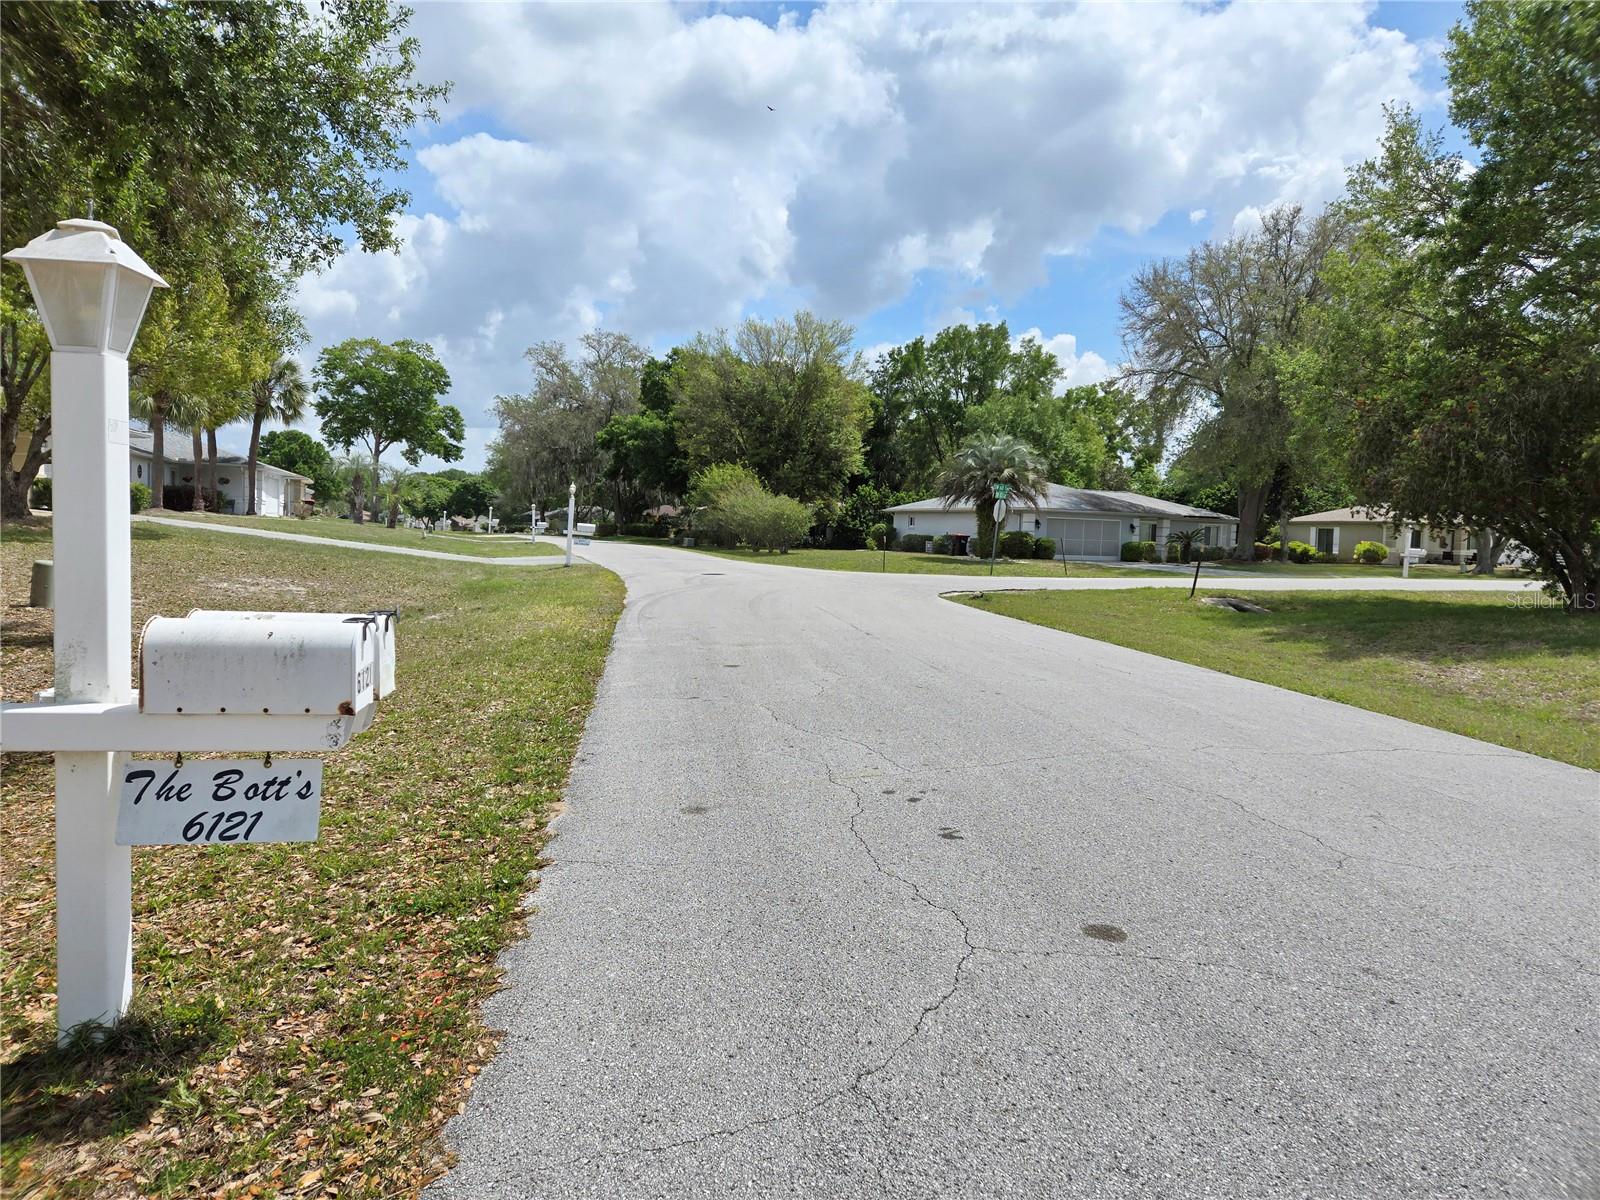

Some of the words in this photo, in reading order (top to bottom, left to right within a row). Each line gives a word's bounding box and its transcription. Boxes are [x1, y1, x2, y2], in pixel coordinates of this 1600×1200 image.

[125, 769, 192, 805] The
[212, 769, 314, 802] Bott's
[182, 811, 264, 842] 6121
